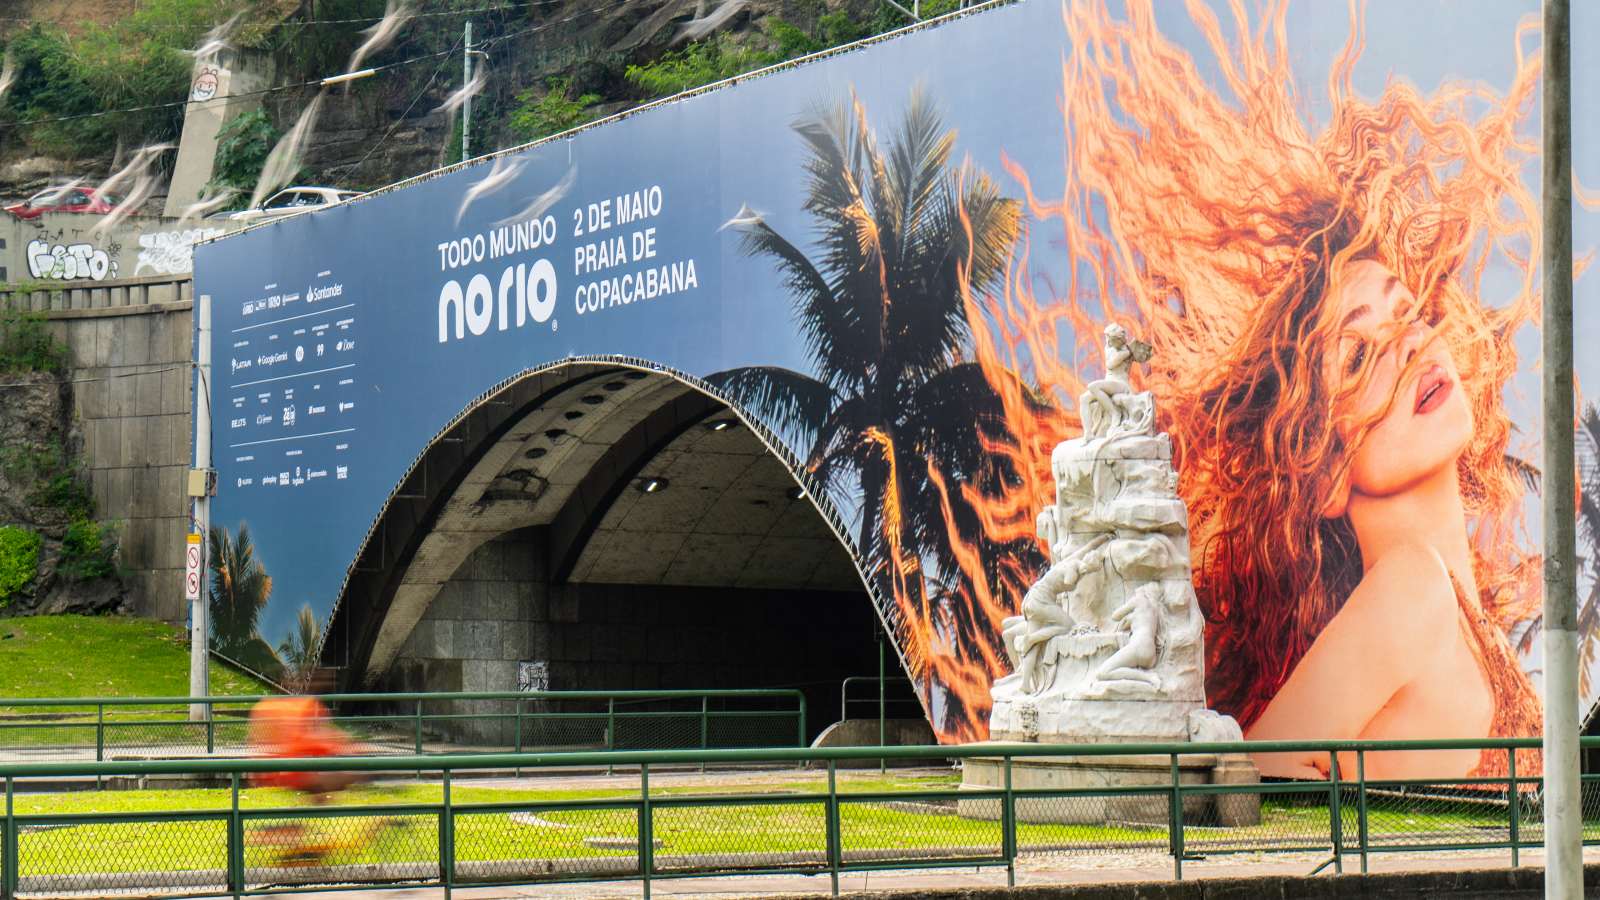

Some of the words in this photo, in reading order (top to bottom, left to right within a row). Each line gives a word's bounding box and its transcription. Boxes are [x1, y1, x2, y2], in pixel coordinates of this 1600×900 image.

[573, 208, 584, 237] 2
[588, 199, 612, 234] DE
[616, 185, 662, 226] MAIO
[438, 234, 486, 271] TODO
[489, 215, 557, 259] MUNDO
[575, 236, 627, 275] PRAIA
[632, 227, 657, 260] DE
[313, 283, 343, 301] Santander
[575, 259, 698, 315] COPACABANA
